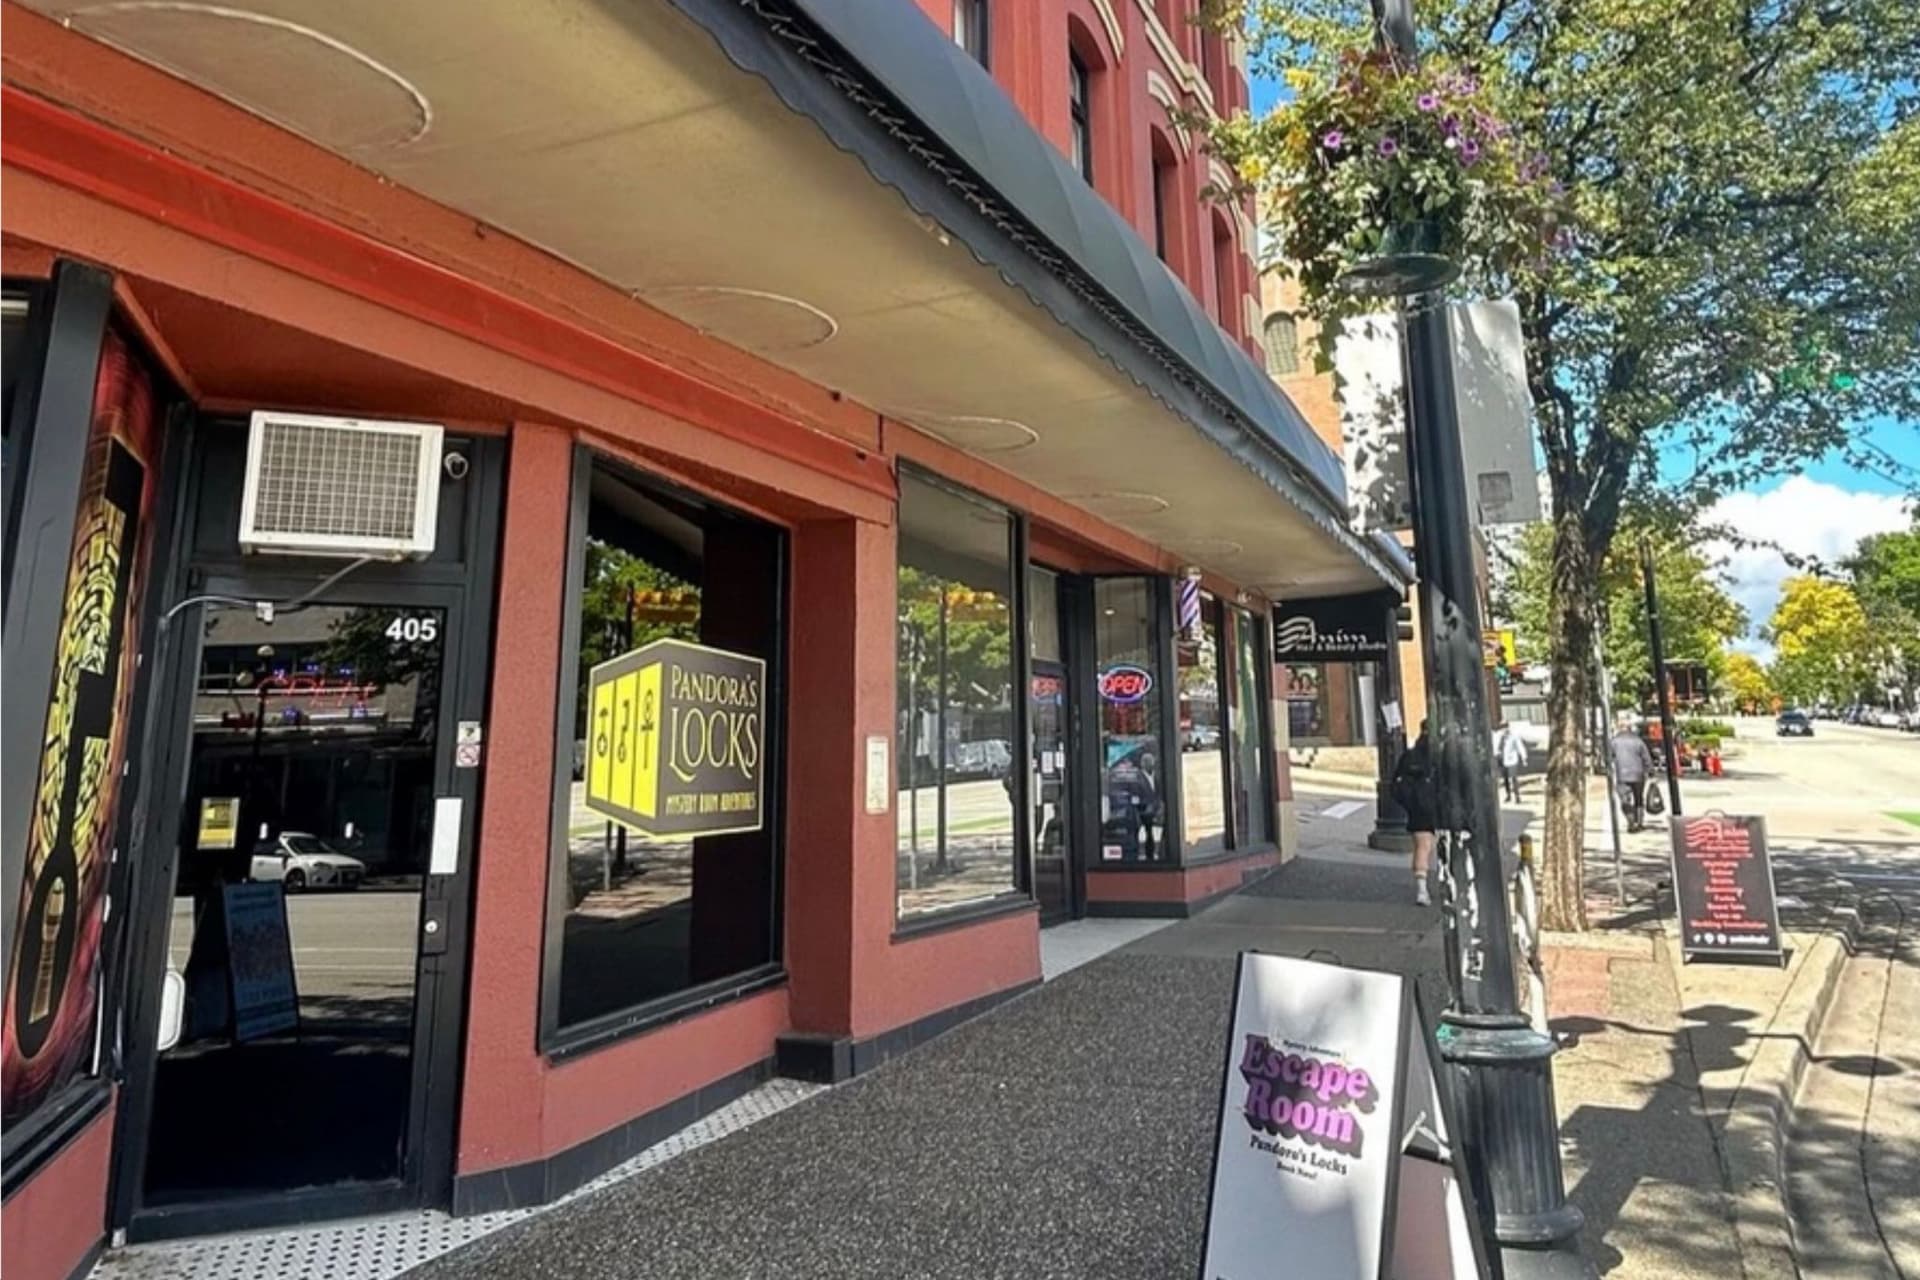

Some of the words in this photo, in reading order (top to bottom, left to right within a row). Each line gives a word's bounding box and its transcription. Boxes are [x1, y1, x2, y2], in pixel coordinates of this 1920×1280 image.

[385, 618, 437, 641] 405
[670, 664, 758, 707] PANDORA'S
[1103, 674, 1146, 695] OPEN
[669, 707, 759, 783] LOCKS
[1241, 1033, 1376, 1106] Escape
[1246, 1076, 1359, 1149] Room
[1250, 1134, 1306, 1163] Pandora's
[1309, 1152, 1348, 1176] Locks
[1277, 1162, 1295, 1173] Book
